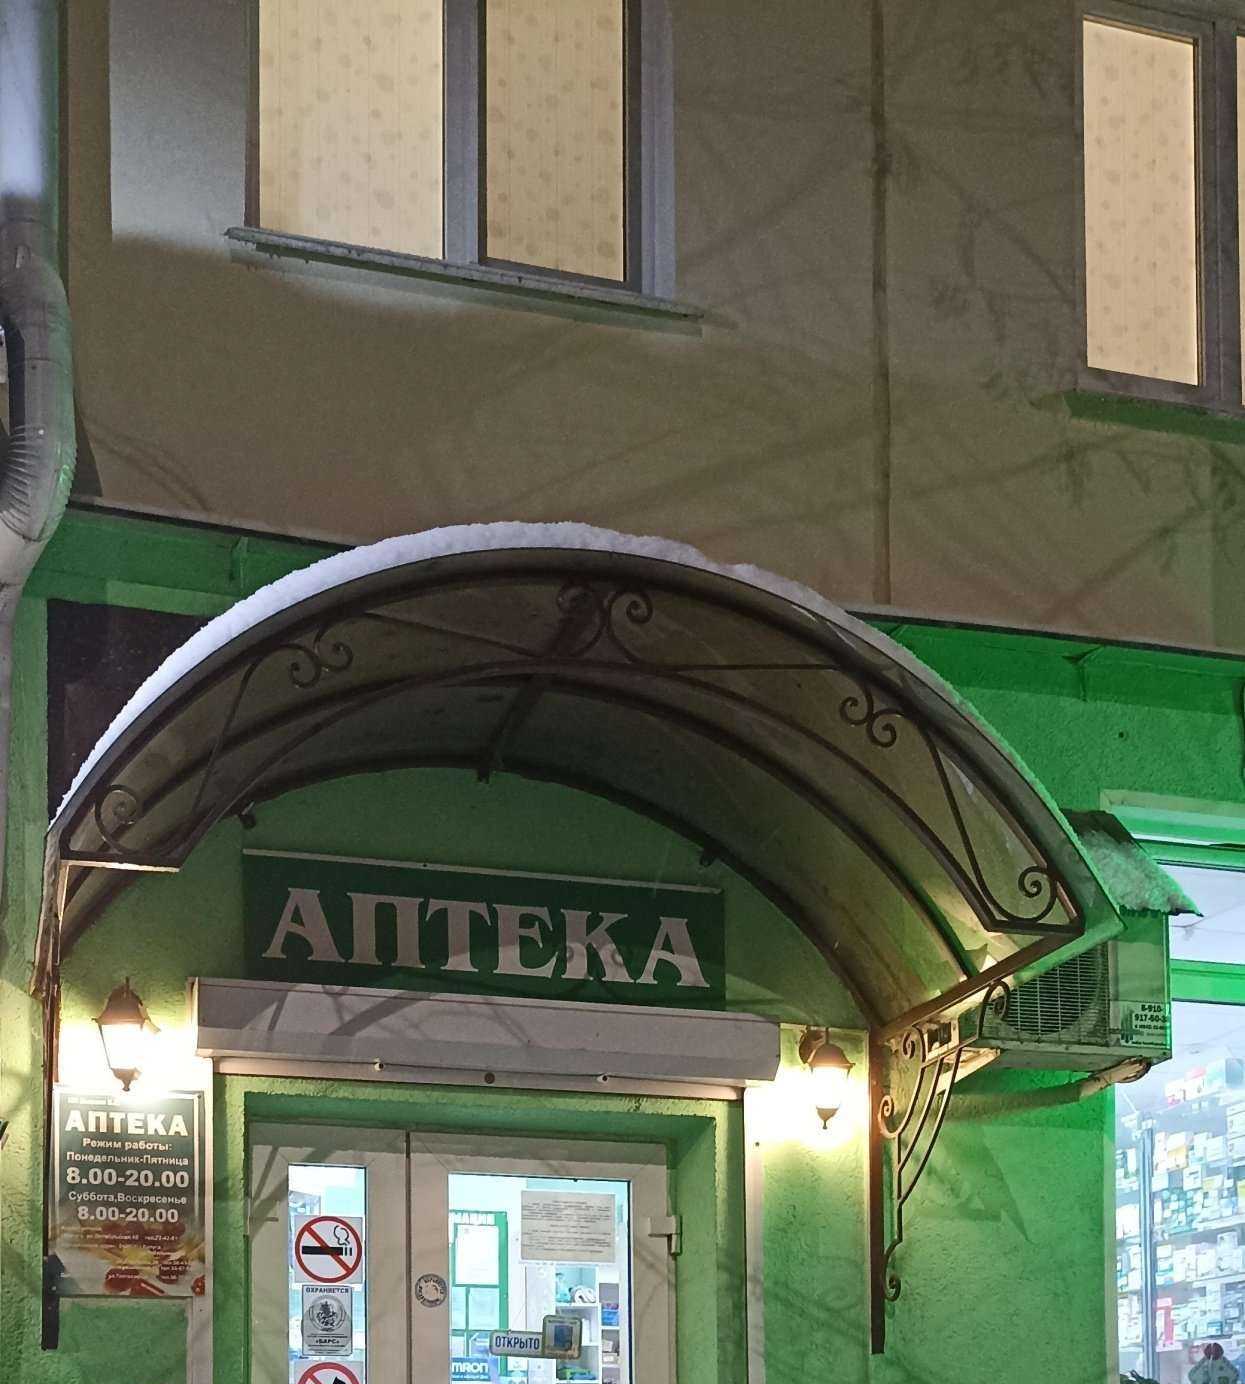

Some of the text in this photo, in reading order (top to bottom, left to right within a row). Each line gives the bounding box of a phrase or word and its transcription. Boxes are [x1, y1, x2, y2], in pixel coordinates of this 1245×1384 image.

[261, 886, 711, 988] АПТЕКА
[64, 1109, 189, 1136] АПТЕКА
[82, 1138, 173, 1151] Режим работы:
[66, 1151, 189, 1166] Понедельник-Пятница
[66, 1166, 190, 1188] 8.00-20.00
[68, 1191, 188, 1205] Суббота,Воскресенье
[77, 1205, 179, 1223] 8.00-20.00
[494, 1335, 540, 1350] ОТКРЫТО
[451, 1361, 489, 1373] MRON
